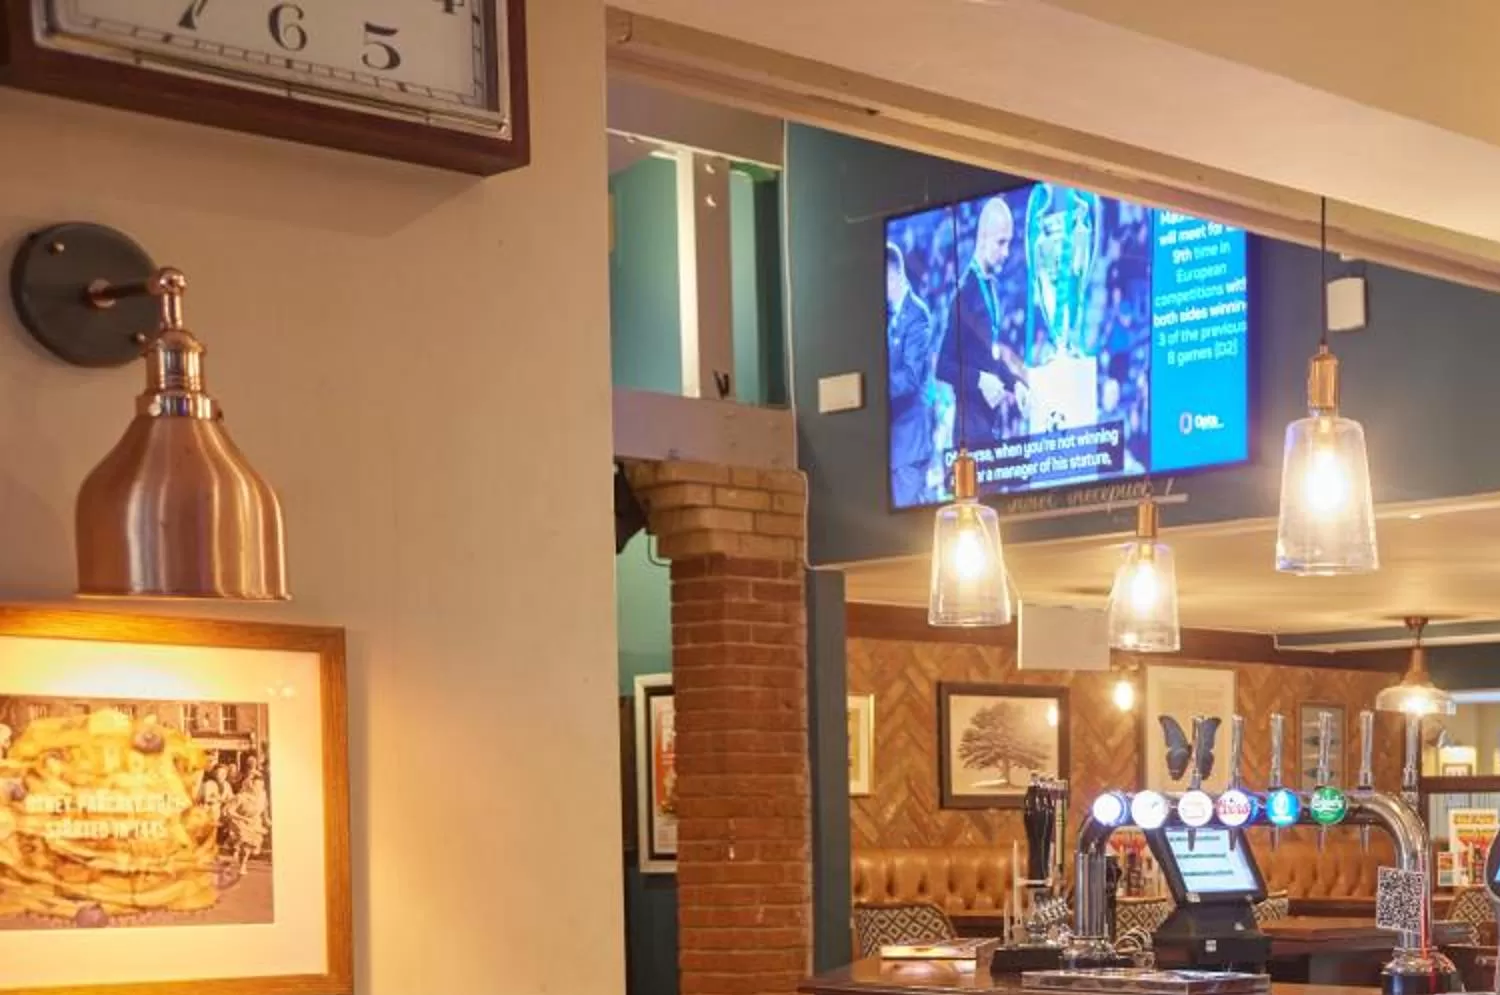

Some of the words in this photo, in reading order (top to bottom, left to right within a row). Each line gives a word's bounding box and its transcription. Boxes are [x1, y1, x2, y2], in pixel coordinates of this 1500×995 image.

[268, 3, 307, 51] 6
[362, 21, 401, 71] 5
[1176, 263, 1227, 284] European
[1177, 347, 1213, 367] games
[995, 441, 1023, 459] when
[1058, 434, 1077, 449] not
[1077, 427, 1119, 447] winning
[994, 462, 1038, 479] manager
[1053, 456, 1069, 470] his
